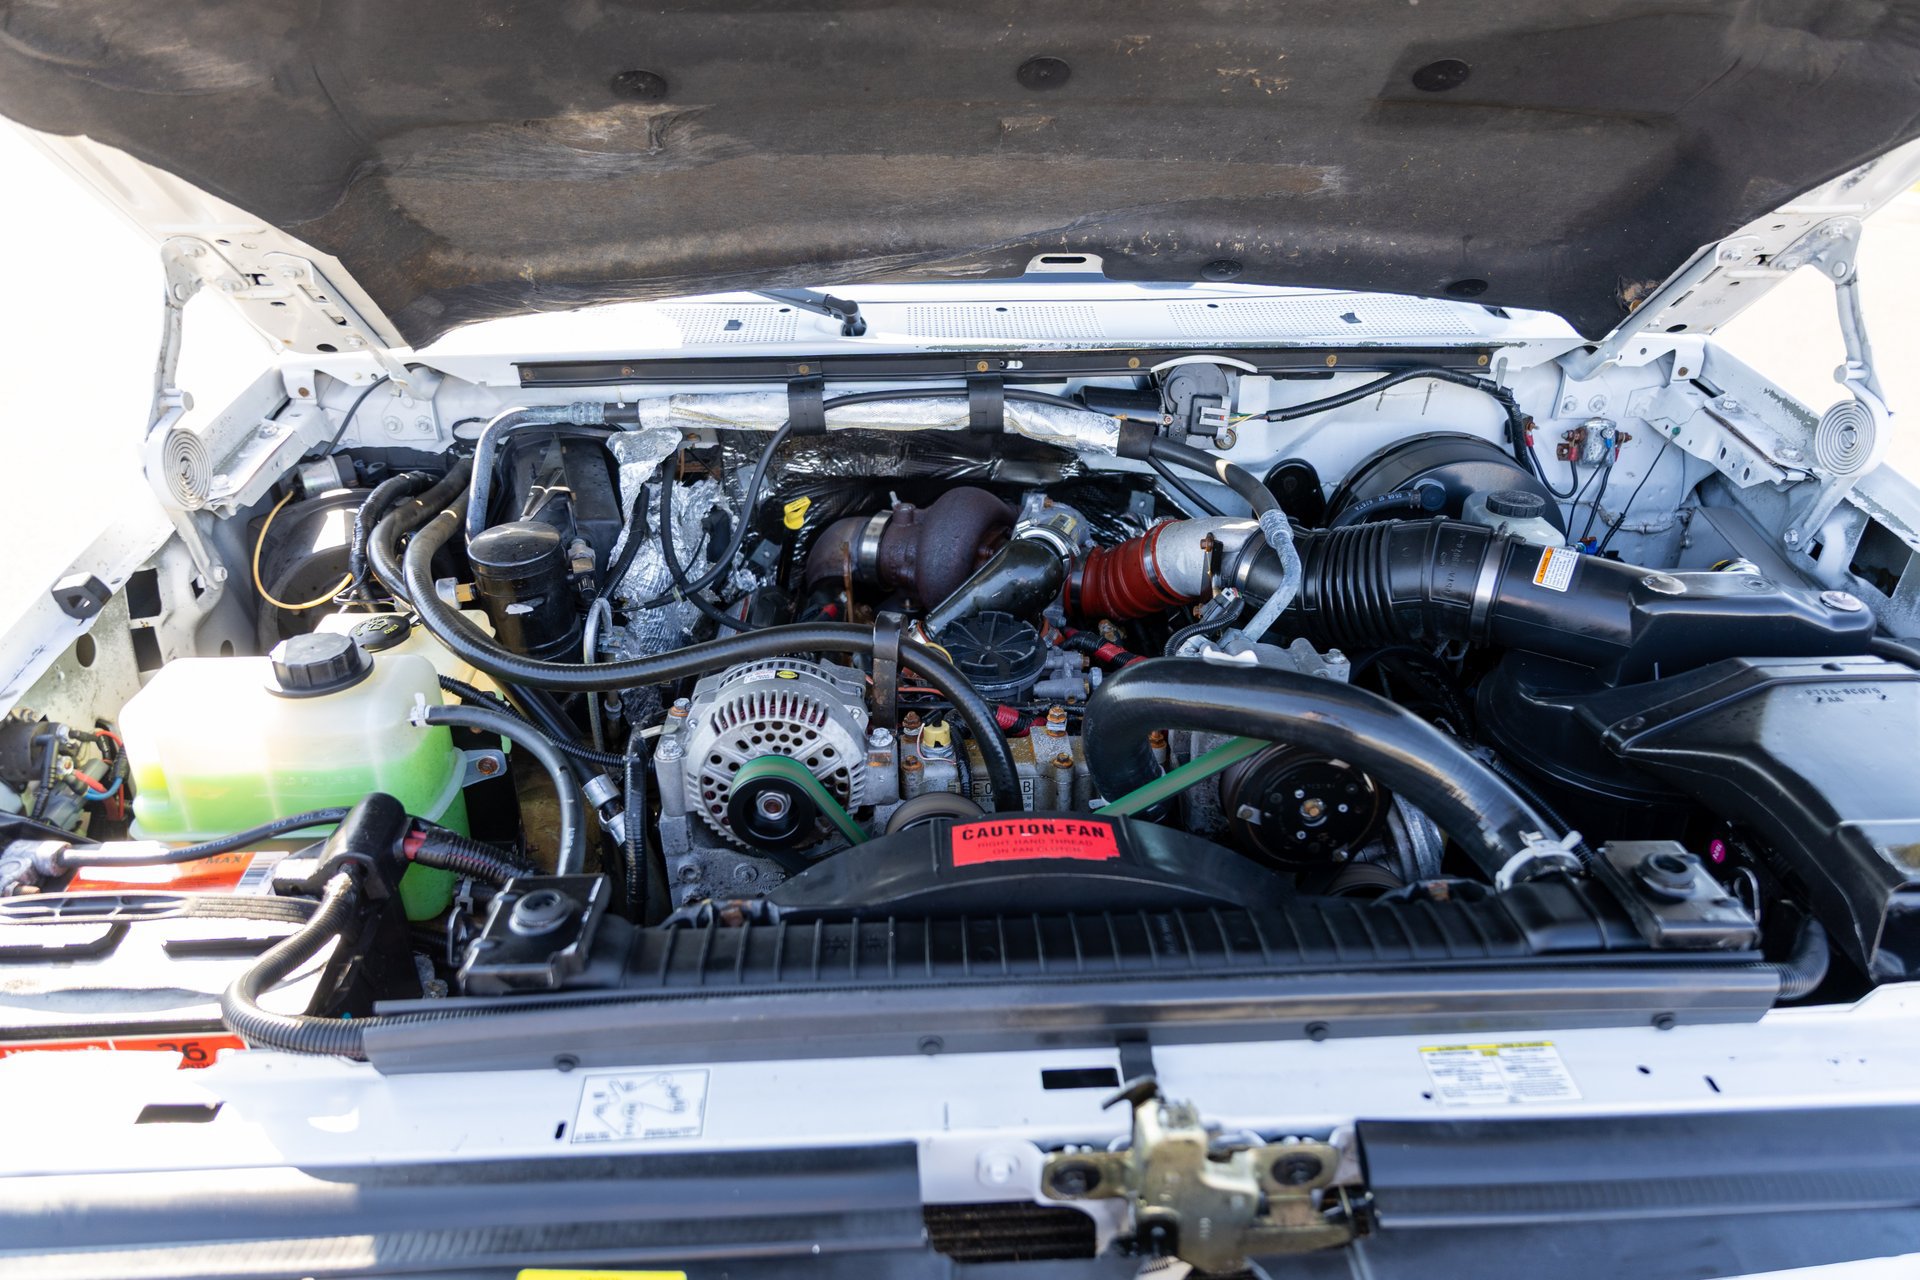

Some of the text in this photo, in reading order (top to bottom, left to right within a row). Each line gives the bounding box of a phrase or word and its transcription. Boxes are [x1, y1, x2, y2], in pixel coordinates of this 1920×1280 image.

[962, 824, 1105, 840] CAUTION-FAN
[1013, 838, 1045, 846] HAND
[1050, 838, 1093, 847] THREAD
[1012, 846, 1034, 854] FAN
